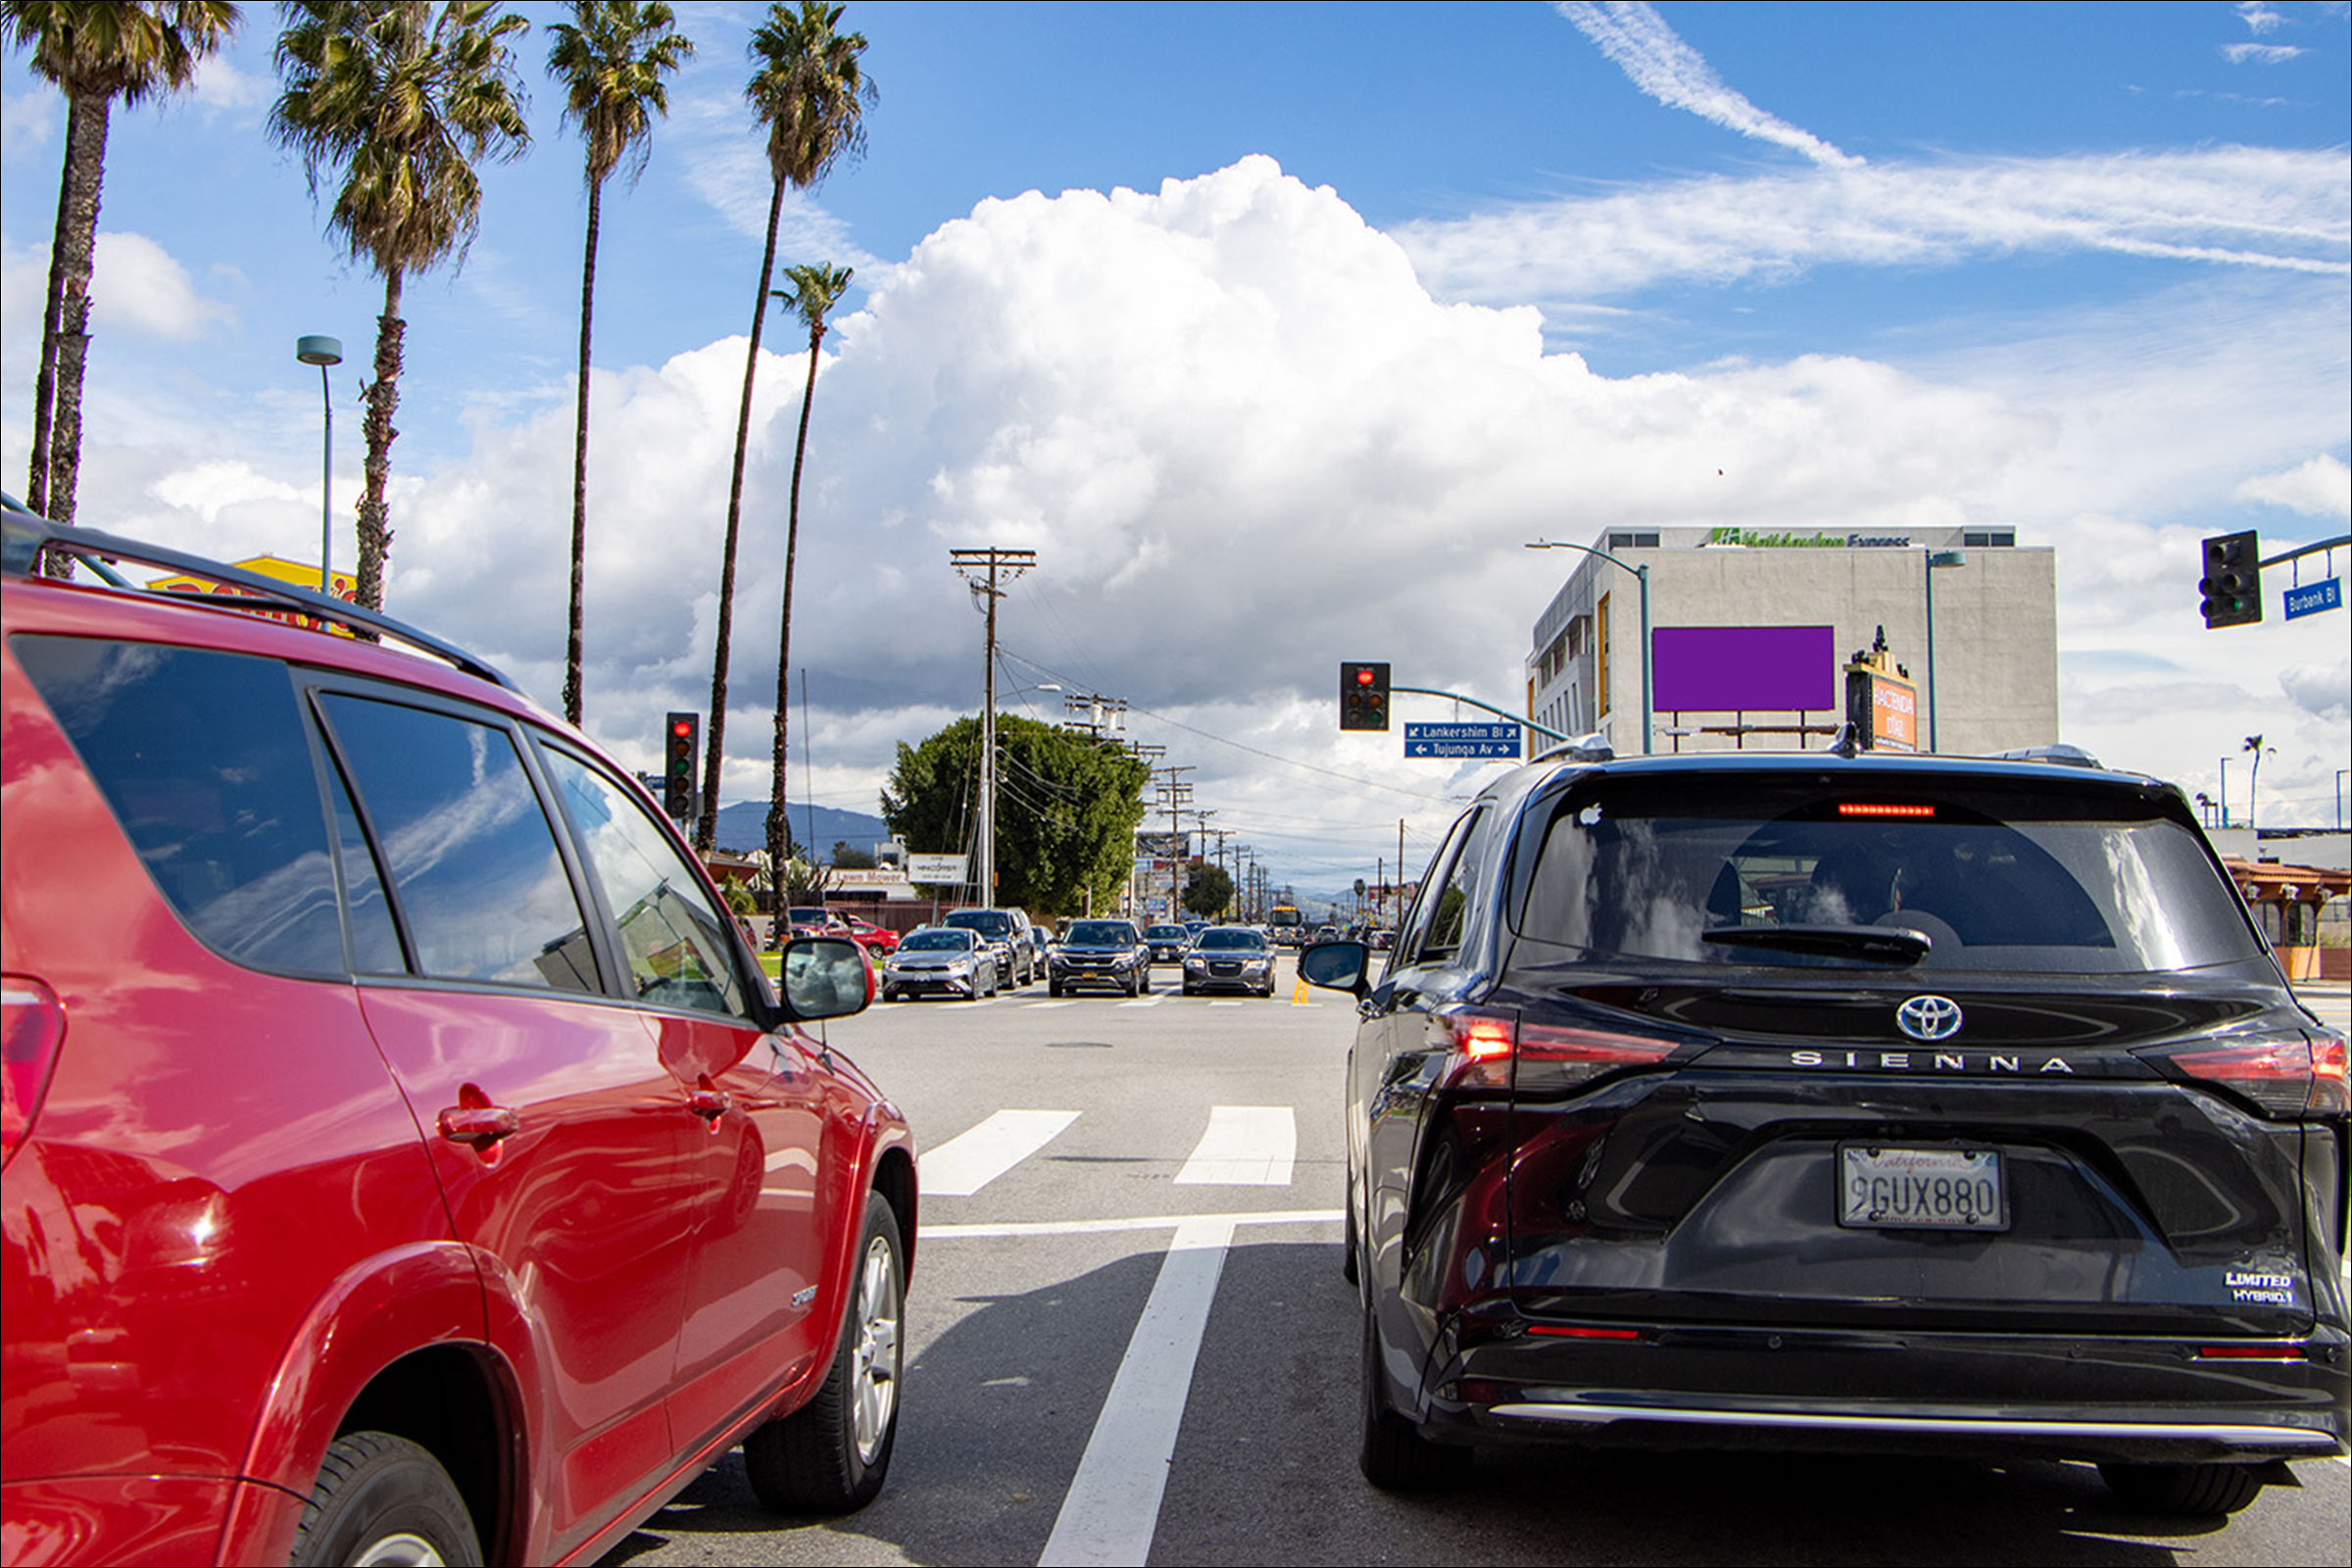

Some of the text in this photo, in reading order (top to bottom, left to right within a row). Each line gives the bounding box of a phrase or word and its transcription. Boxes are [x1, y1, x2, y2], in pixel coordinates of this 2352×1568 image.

[1815, 530, 1846, 548] Inn
[1847, 533, 1910, 548] Express
[2289, 586, 2335, 612] Burbank Bl
[1423, 726, 1488, 738] Lankershim
[1433, 743, 1494, 760] Tujunga Av
[835, 870, 863, 881] Lawn
[867, 870, 901, 882] Mower
[1790, 1050, 2075, 1074] SIENNA
[1851, 1175, 1993, 1216] 9GUX880
[2226, 1272, 2293, 1288] LIMITED
[2233, 1289, 2285, 1304] HYBRID
